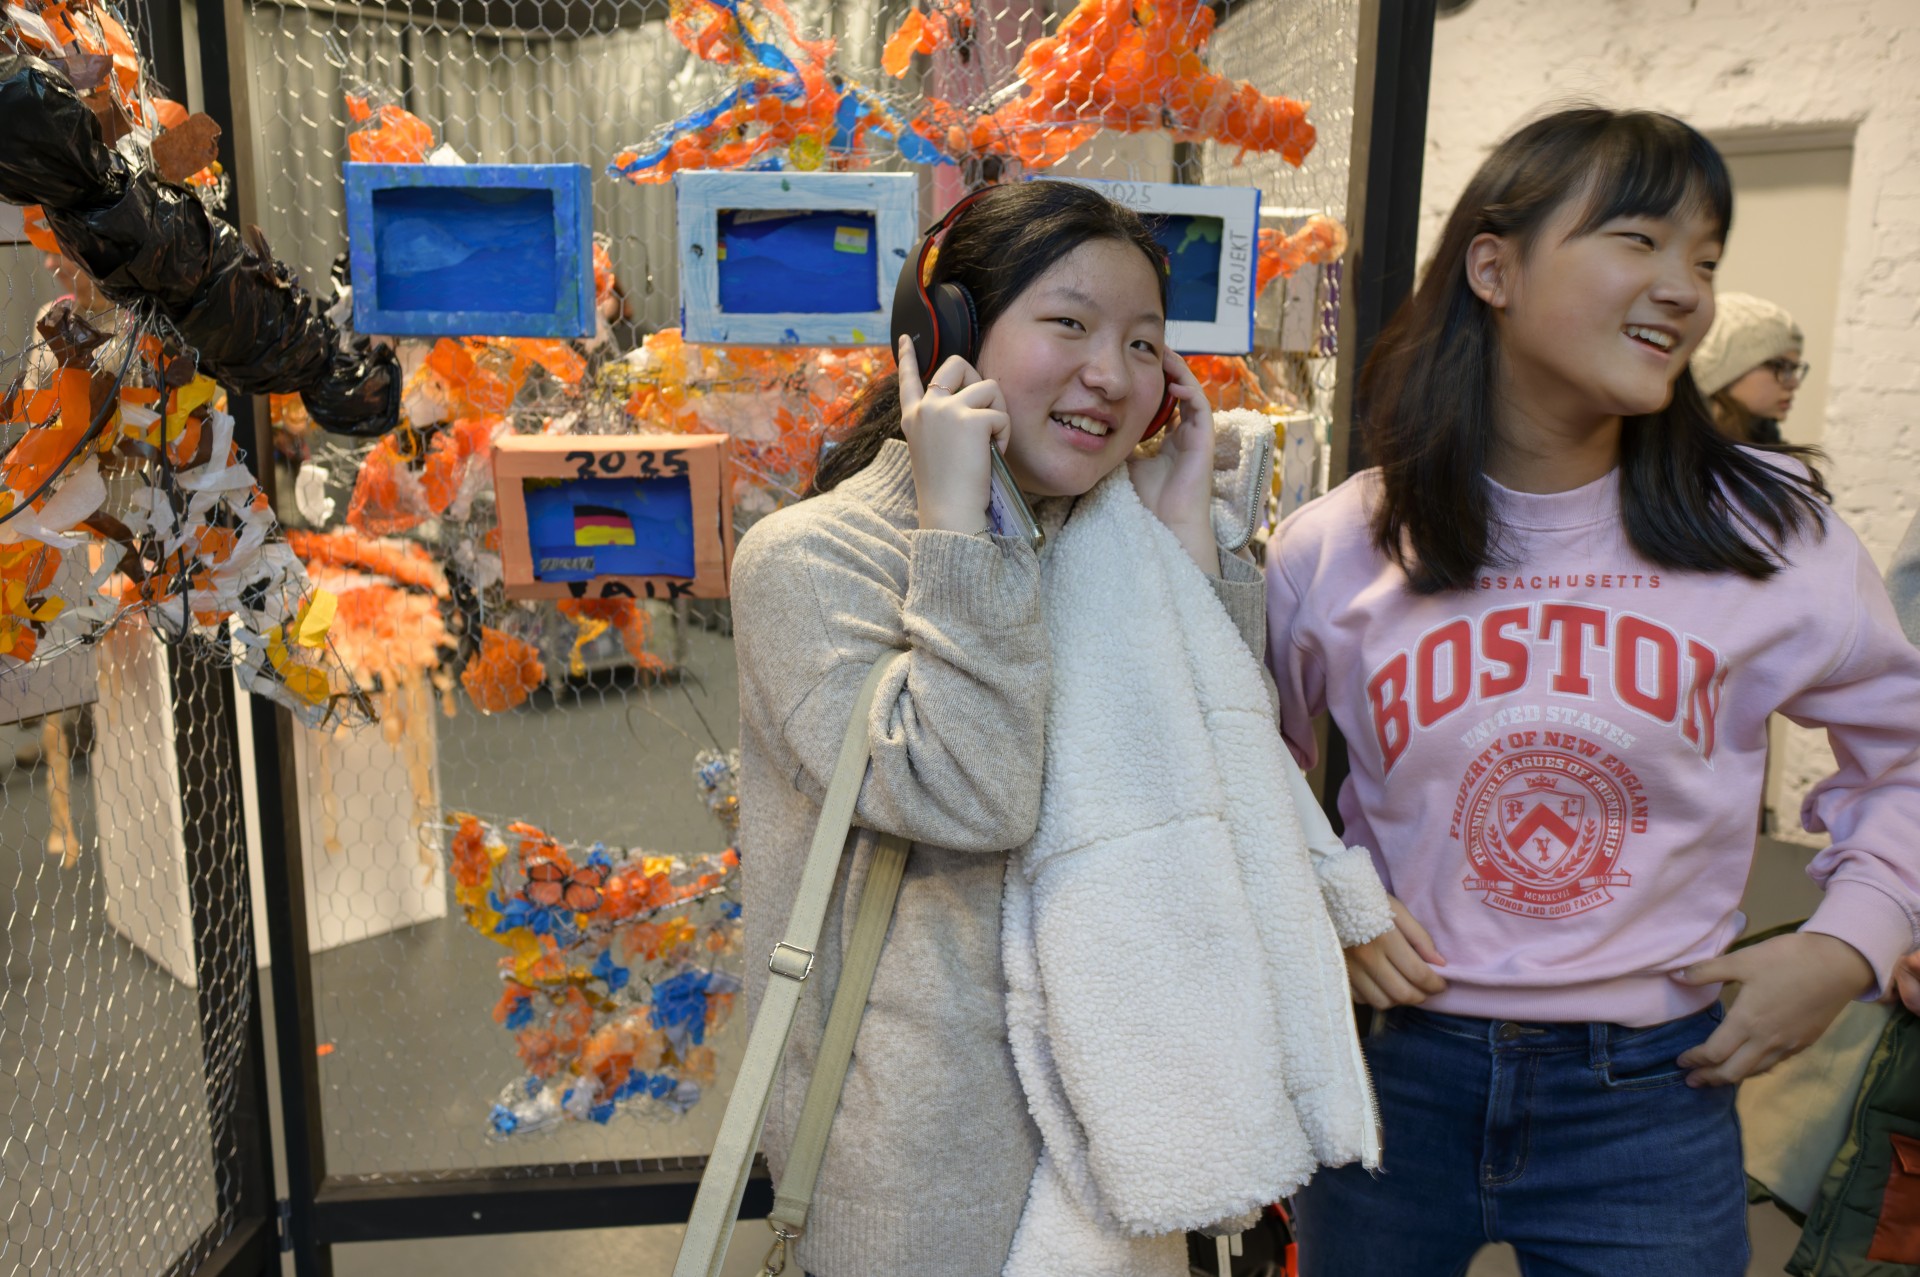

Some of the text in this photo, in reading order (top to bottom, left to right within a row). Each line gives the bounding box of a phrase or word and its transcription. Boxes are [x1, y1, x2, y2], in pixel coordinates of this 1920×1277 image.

[1225, 230, 1249, 308] PROJEKT
[565, 449, 690, 478] 2025
[1471, 574, 1661, 590] SSACHUSETTS
[1365, 600, 1729, 785] BOSTON
[1460, 704, 1637, 750] UNITED STATES
[1449, 730, 1649, 841] PROPERTY OF NEW ENGLAND
[1471, 781, 1497, 838] UNITED
[1494, 756, 1565, 784] LEAGUES
[1566, 762, 1589, 778] OF
[1586, 774, 1620, 858] FRIENDSHIP
[1492, 891, 1603, 915] HONOR AND GOOD FAITH
[1523, 890, 1570, 902] MCMXCVII
